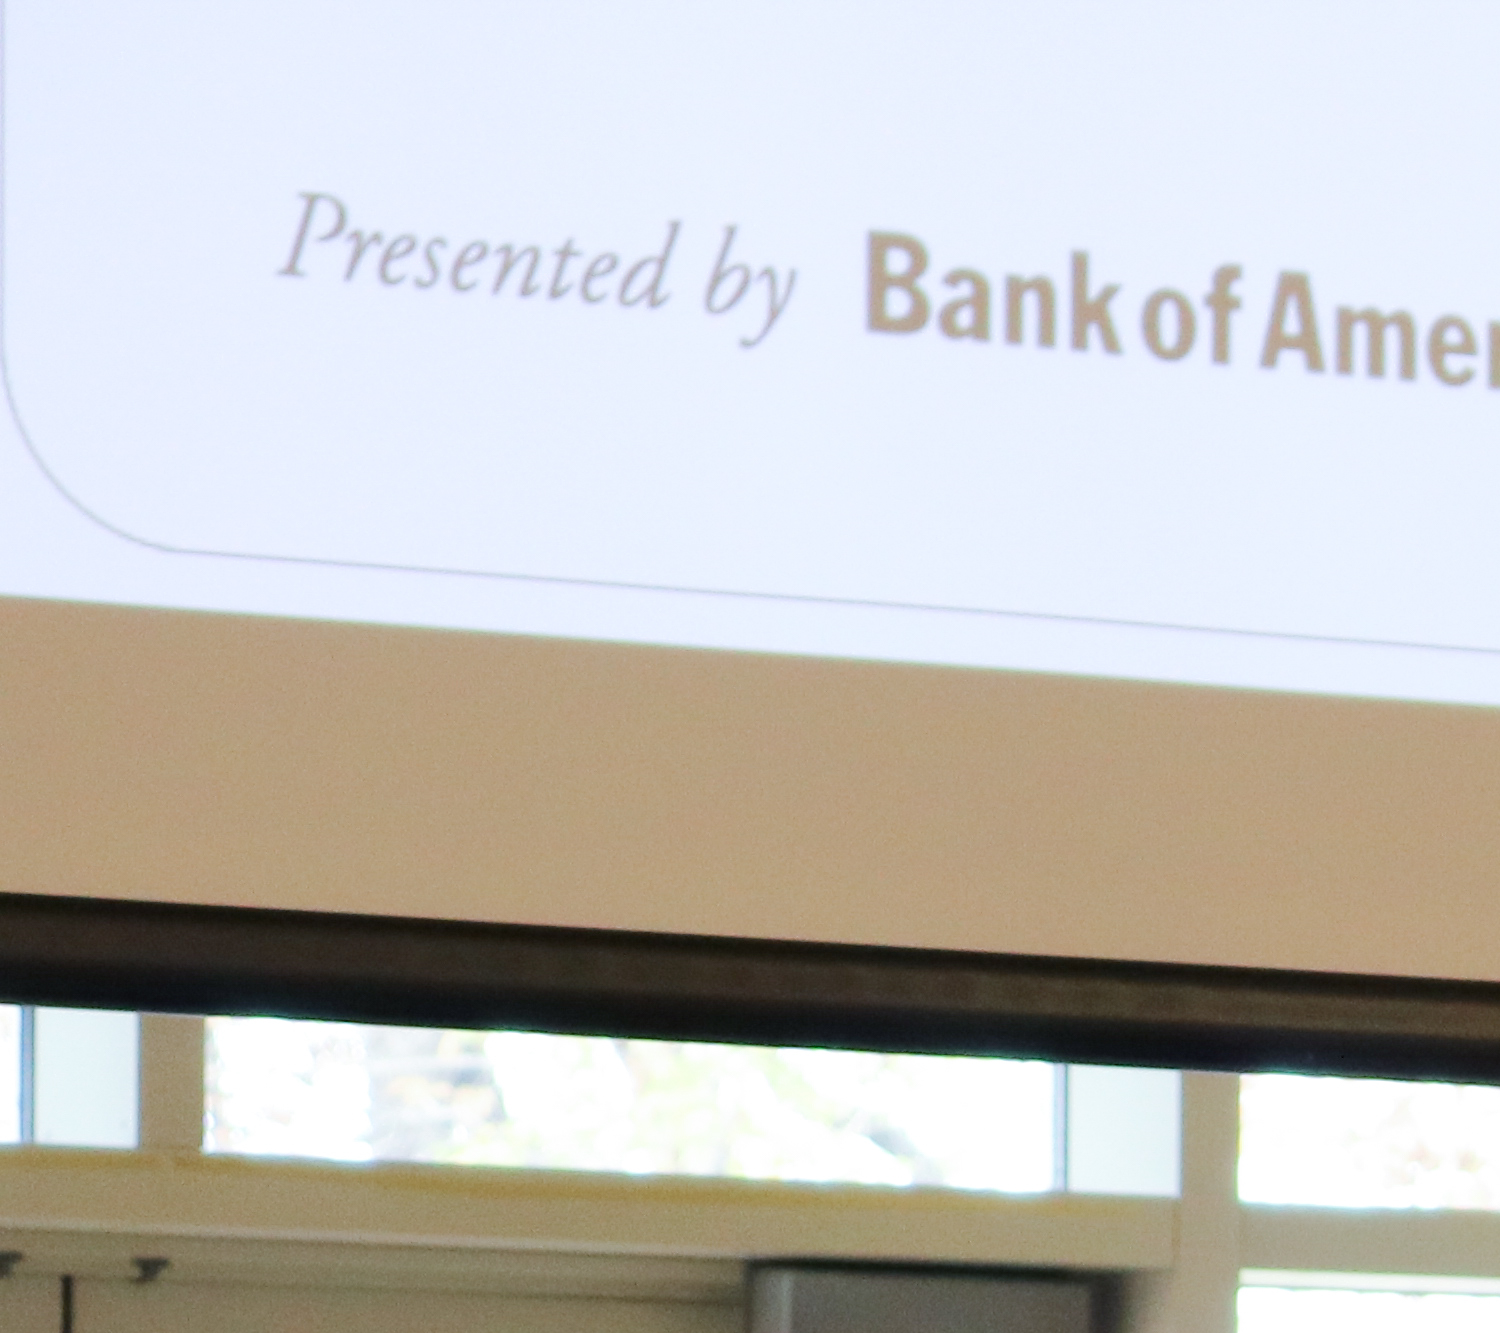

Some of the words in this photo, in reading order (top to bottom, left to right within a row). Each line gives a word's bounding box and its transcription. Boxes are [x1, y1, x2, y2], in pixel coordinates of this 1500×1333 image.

[277, 190, 683, 310] Presented
[703, 224, 799, 350] by
[866, 230, 1124, 357] Bank
[1139, 263, 1244, 366] of
